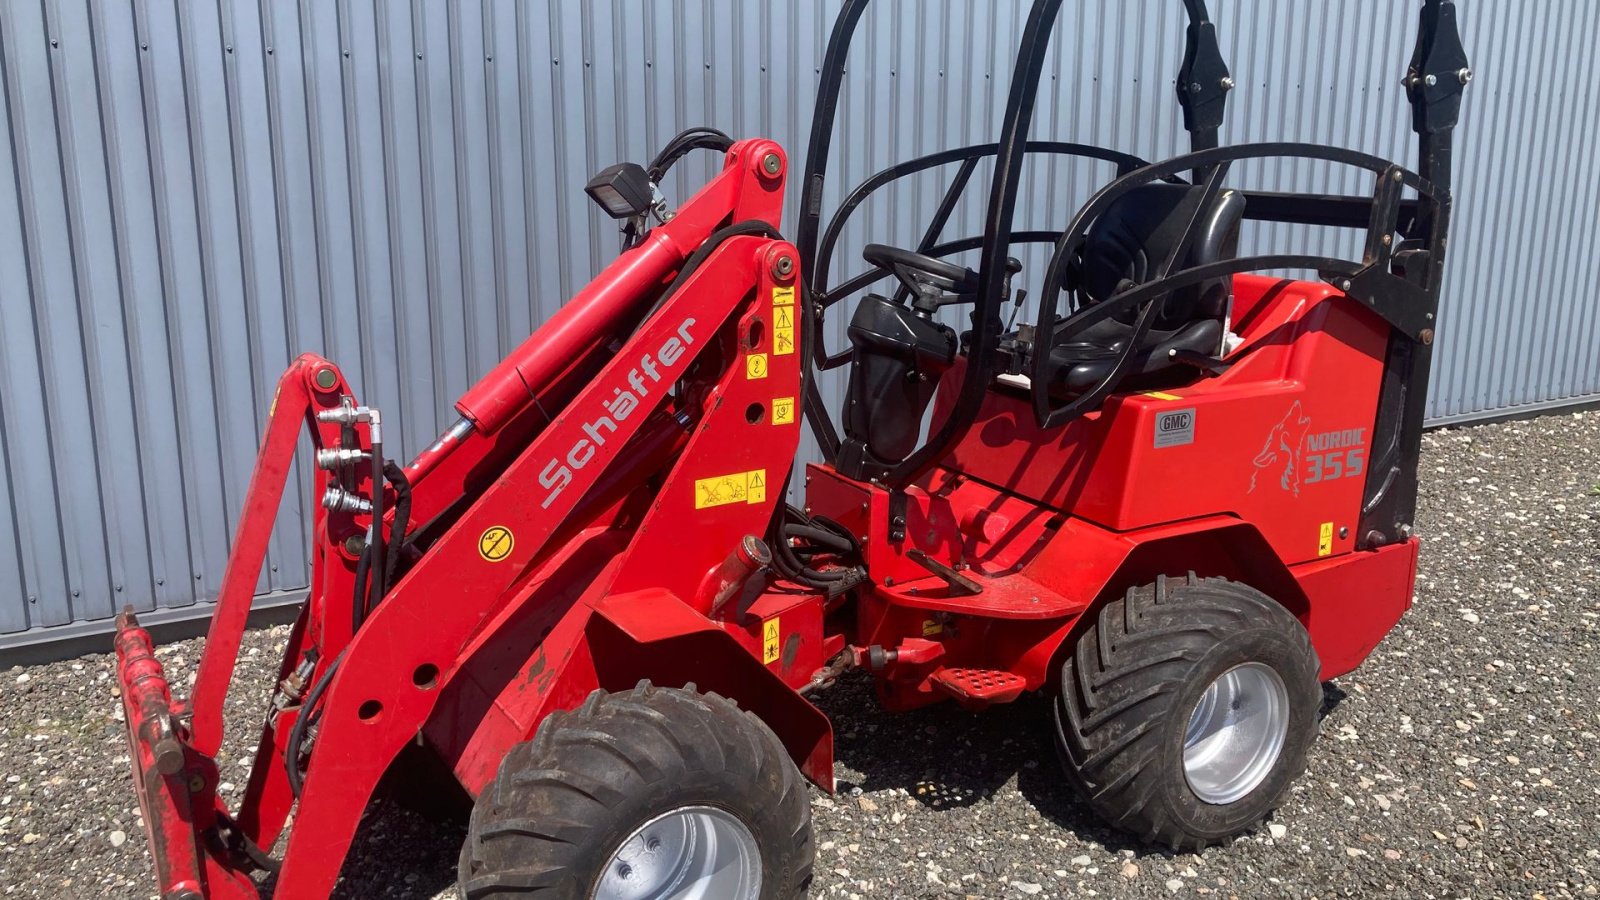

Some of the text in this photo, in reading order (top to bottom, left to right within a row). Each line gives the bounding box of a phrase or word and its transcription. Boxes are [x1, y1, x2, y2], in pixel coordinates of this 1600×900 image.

[538, 317, 696, 509] Schäffer
[1163, 414, 1187, 430] GMC
[1307, 427, 1366, 452] NORDIC
